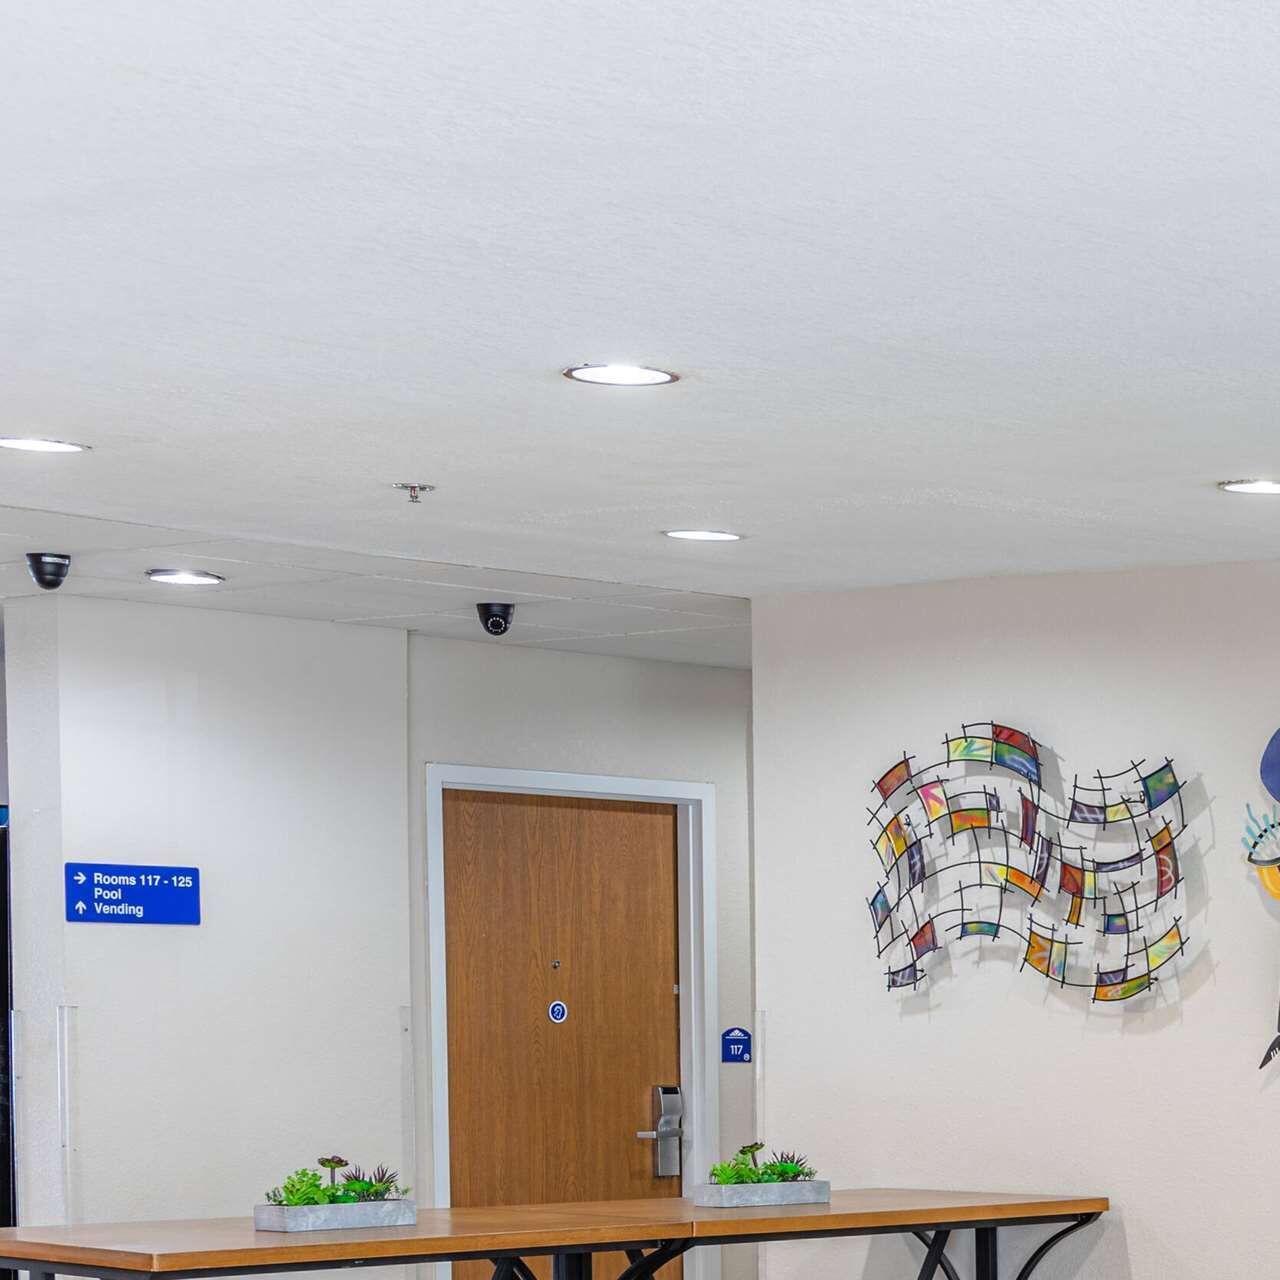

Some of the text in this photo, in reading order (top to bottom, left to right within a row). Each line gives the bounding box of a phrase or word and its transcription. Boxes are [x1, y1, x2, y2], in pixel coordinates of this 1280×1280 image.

[93, 872, 137, 886] Rooms
[139, 874, 161, 887] 117
[171, 875, 193, 888] 125
[93, 887, 122, 900] Pool
[93, 902, 144, 918] Vending
[730, 1044, 743, 1055] 117
